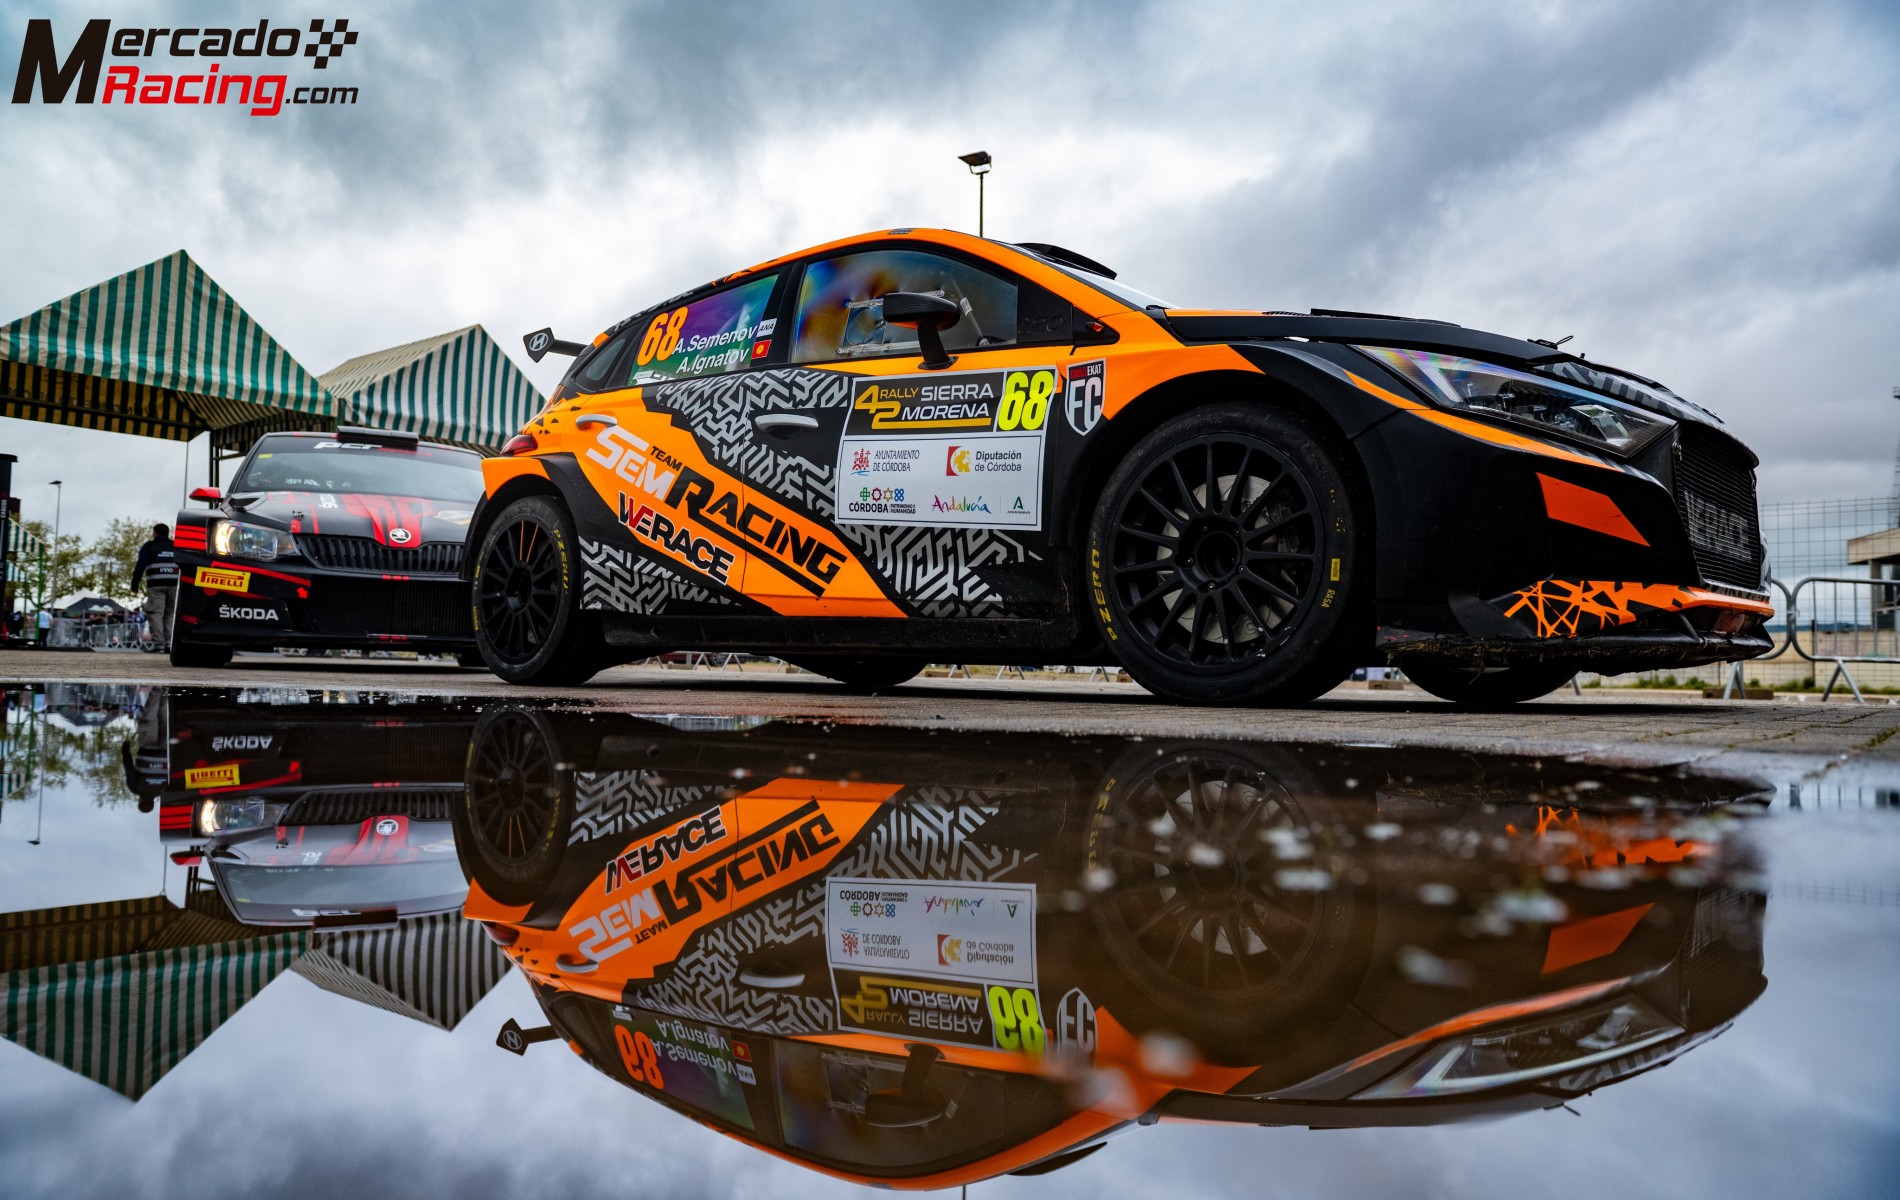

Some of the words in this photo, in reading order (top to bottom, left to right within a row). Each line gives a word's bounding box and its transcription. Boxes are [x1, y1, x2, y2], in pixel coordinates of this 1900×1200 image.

[637, 306, 688, 366] 68
[672, 324, 758, 355] A.Semenov
[676, 348, 750, 374] A.Ignatov
[880, 387, 918, 400] RALLY
[920, 383, 994, 402] SIERRA
[998, 370, 1054, 431] 68
[901, 403, 990, 421] MORENA
[1069, 376, 1102, 430] FC
[651, 446, 683, 472] TEAM
[875, 449, 921, 460] AYUNTAMIENTO
[976, 450, 1022, 463] Diputación
[873, 462, 881, 472] DE
[881, 461, 911, 472] CÓRDOBA
[974, 463, 984, 472] de
[986, 461, 1022, 472] Córdoba
[849, 501, 889, 514] CÓRDOBA
[931, 494, 993, 514] Andalucía
[199, 571, 246, 588] PIRELLI
[218, 604, 279, 621] ŠKODA
